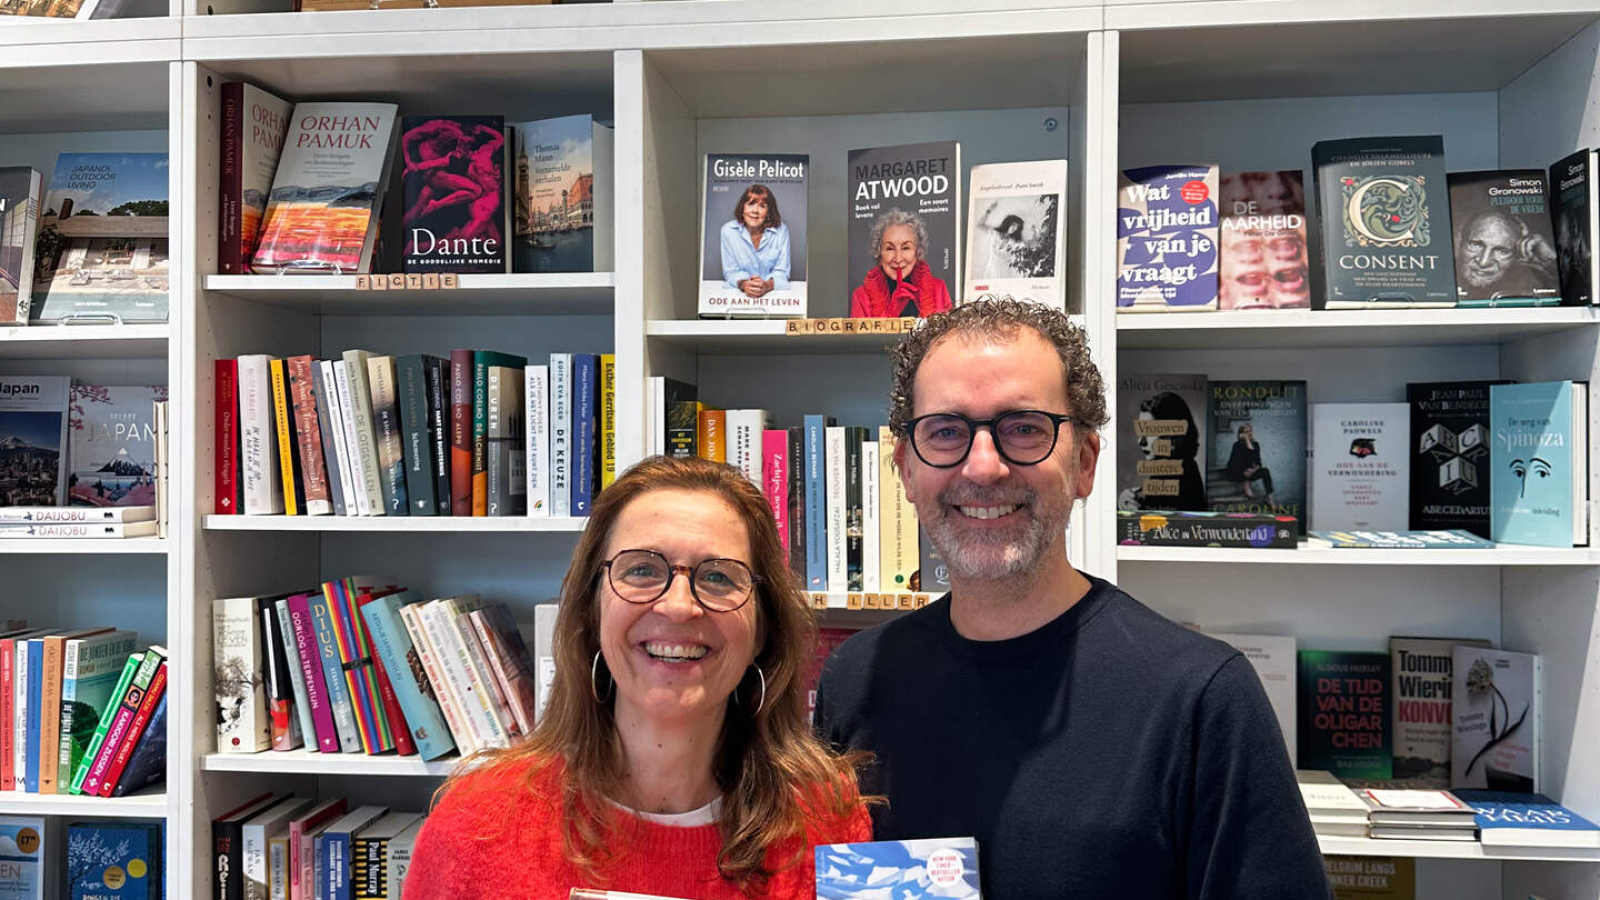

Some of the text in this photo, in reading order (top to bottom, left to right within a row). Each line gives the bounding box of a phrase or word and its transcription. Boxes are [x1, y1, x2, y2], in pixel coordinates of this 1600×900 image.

[251, 103, 288, 130] ORHA
[300, 115, 381, 131] ORHAN
[225, 99, 236, 175] ORHAN PAMUK
[296, 132, 374, 149] PAMUK
[535, 144, 560, 153] Thomas
[71, 165, 112, 173] JAPANDI
[713, 158, 804, 178] Gisèle Pelicot
[855, 157, 949, 181] MARGARET
[1568, 163, 1585, 176] Simon
[69, 173, 117, 181] OUTDOOR
[1509, 179, 1542, 187] Simon
[1560, 175, 1585, 191] Gronowski
[67, 181, 97, 190] LIVING
[855, 175, 949, 201] ATWOOD
[1127, 183, 1171, 203] Wat
[1488, 187, 1543, 196] Gronowski
[918, 206, 949, 214] memoires
[1233, 201, 1258, 215] DE
[1522, 204, 1545, 214] VREDE
[1122, 206, 1211, 232] vrijheid
[1221, 214, 1302, 231] AARHEID
[410, 227, 498, 256] Dante
[1144, 233, 1211, 258] van je
[1338, 254, 1439, 270] CONSENT
[357, 276, 453, 287] FICTIE
[1122, 263, 1198, 286] vraagt
[708, 298, 801, 307] ODE AAN HET LEVEN
[788, 320, 911, 332] BIOGRAFIE
[296, 360, 306, 379] Jane
[1119, 378, 1146, 391] Alicia
[298, 379, 308, 408] Austen
[1213, 387, 1298, 399] RONDUIT
[1431, 389, 1483, 399] JEAN PAUL
[490, 375, 498, 430] DE UREN
[1219, 401, 1291, 409] OVERPEINZINGEN
[1419, 401, 1439, 410] VAN
[302, 412, 313, 434] Trots
[605, 362, 615, 473] Esther Gerritsen Gebied 19
[1508, 417, 1551, 428] De weg van
[87, 423, 155, 442] JAPAN
[433, 386, 441, 408] CONRAD
[437, 441, 445, 477] DUISTERNIS
[476, 423, 482, 432] DE
[707, 419, 716, 438] DAN
[1138, 422, 1184, 434] Vrouwen
[556, 429, 565, 444] DE
[1497, 429, 1564, 454] Spinoza
[358, 414, 375, 493] DE LOTGEVALLEN
[410, 432, 421, 472] Schemering
[475, 435, 483, 471] ALCHEMIST
[1157, 443, 1168, 453] in
[221, 459, 231, 486] vleugels
[556, 450, 565, 489] KEUZE
[1138, 463, 1181, 474] duistere
[771, 453, 783, 519] Zachtjes, neem
[1146, 482, 1178, 495] tijden
[36, 511, 87, 522] DAIJOBU
[1213, 503, 1298, 514] CAROLINE
[1422, 504, 1491, 515] ABECEDARIU
[39, 525, 88, 536] DAIJOBU
[1152, 524, 1181, 540] Alice
[1190, 524, 1268, 541] Verwonderland
[313, 603, 335, 659] DIUS
[292, 611, 320, 708] OORLOG TERPENTIJN
[1398, 650, 1452, 677] Tommy
[134, 659, 150, 684] ITAMI
[143, 657, 159, 682] EMILY
[1350, 665, 1381, 673] HUXLEY
[329, 667, 340, 690] STEFAN
[1317, 678, 1383, 694] DE TIJD
[1316, 697, 1383, 712] VAN DE
[62, 711, 72, 733] JONGEN
[117, 673, 164, 763] OSAMU DAZAI ALS MENS MISLUKT
[1314, 714, 1383, 730] OLIGAR
[1458, 713, 1484, 722] Tommy
[93, 710, 129, 776] KAKIGORI ZUSSEN
[1331, 733, 1382, 749] CHEN
[367, 841, 379, 895] Paul Murray
[1363, 862, 1397, 875] LANGS
[1357, 875, 1389, 888] CREEK
